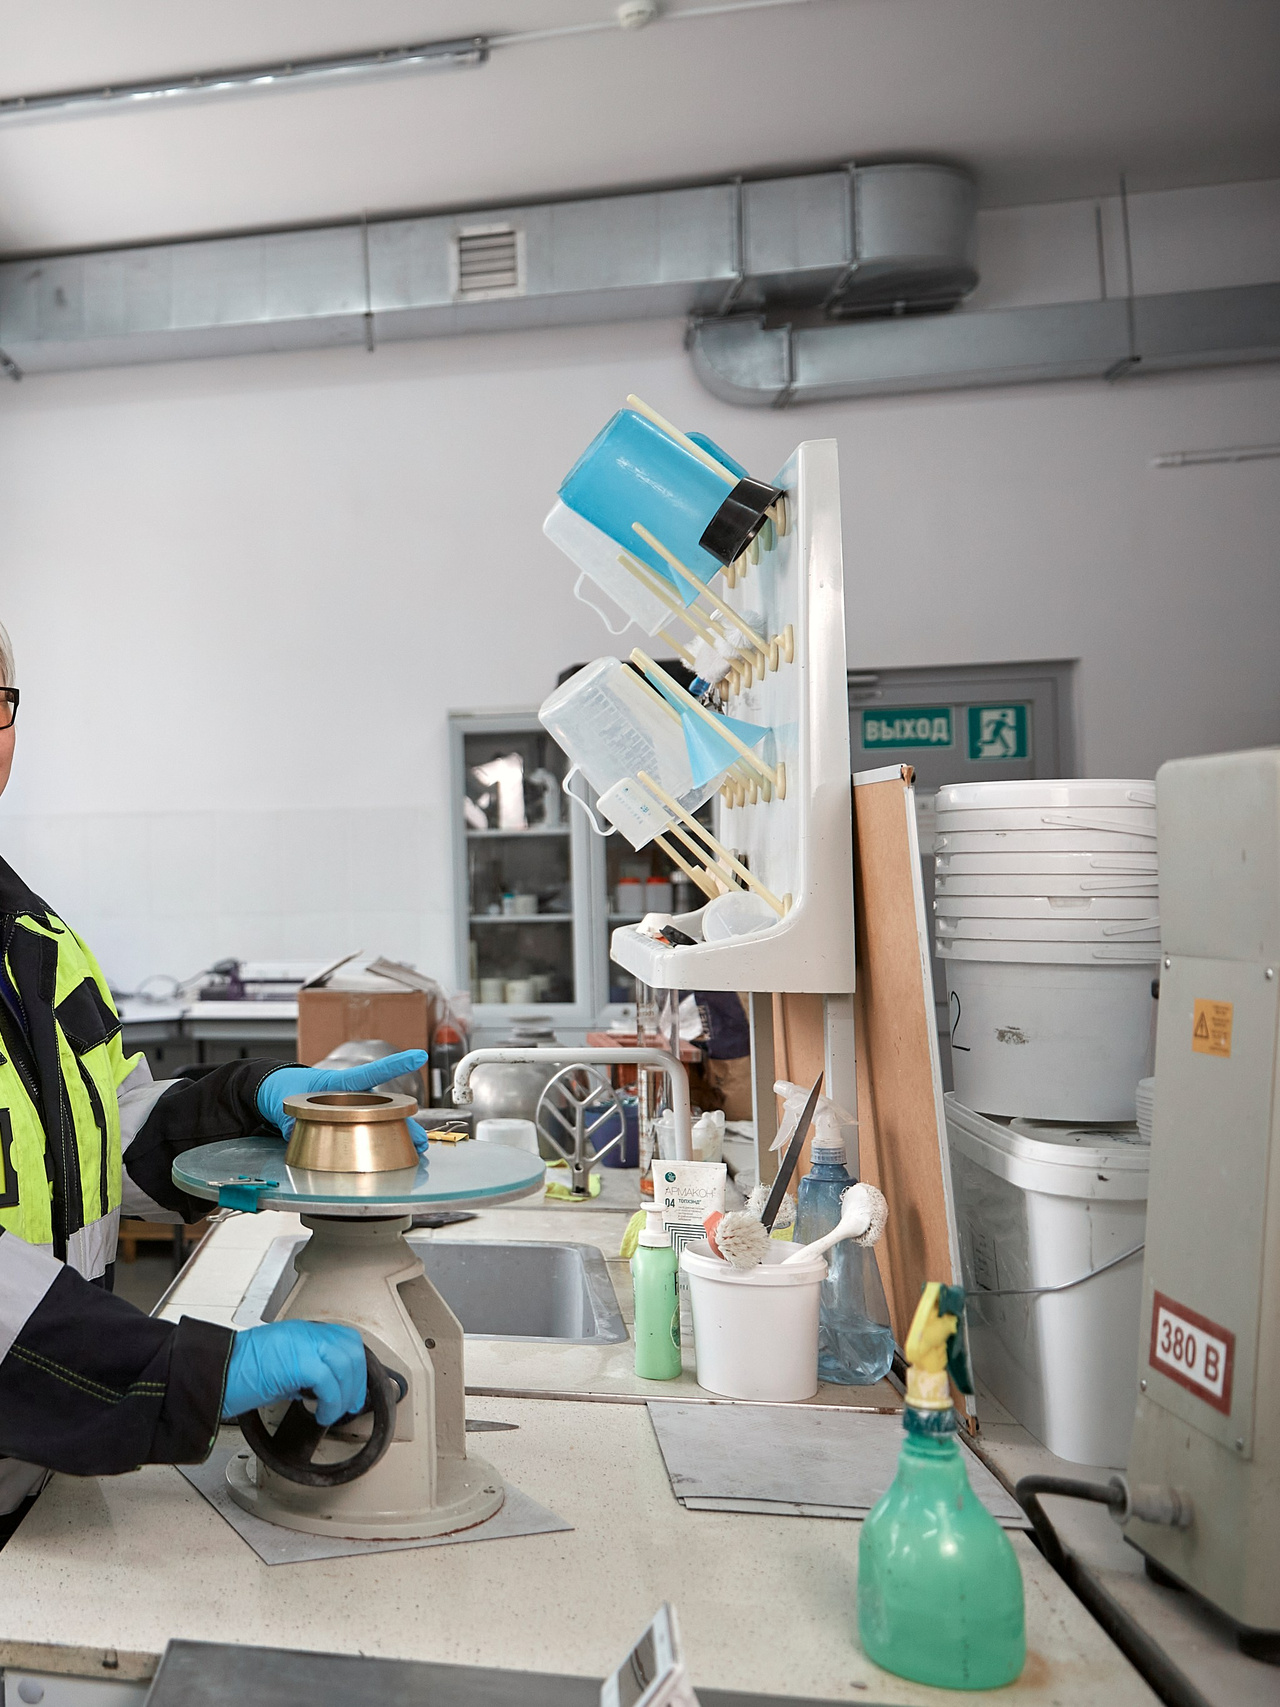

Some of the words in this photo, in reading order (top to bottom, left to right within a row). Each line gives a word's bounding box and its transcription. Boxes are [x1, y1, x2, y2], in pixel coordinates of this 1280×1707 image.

[865, 717, 949, 743] ВЫХОД
[951, 991, 970, 1051] 2
[665, 1198, 675, 1207] 04
[1161, 1319, 1196, 1369] 380
[1204, 1343, 1220, 1383] В
